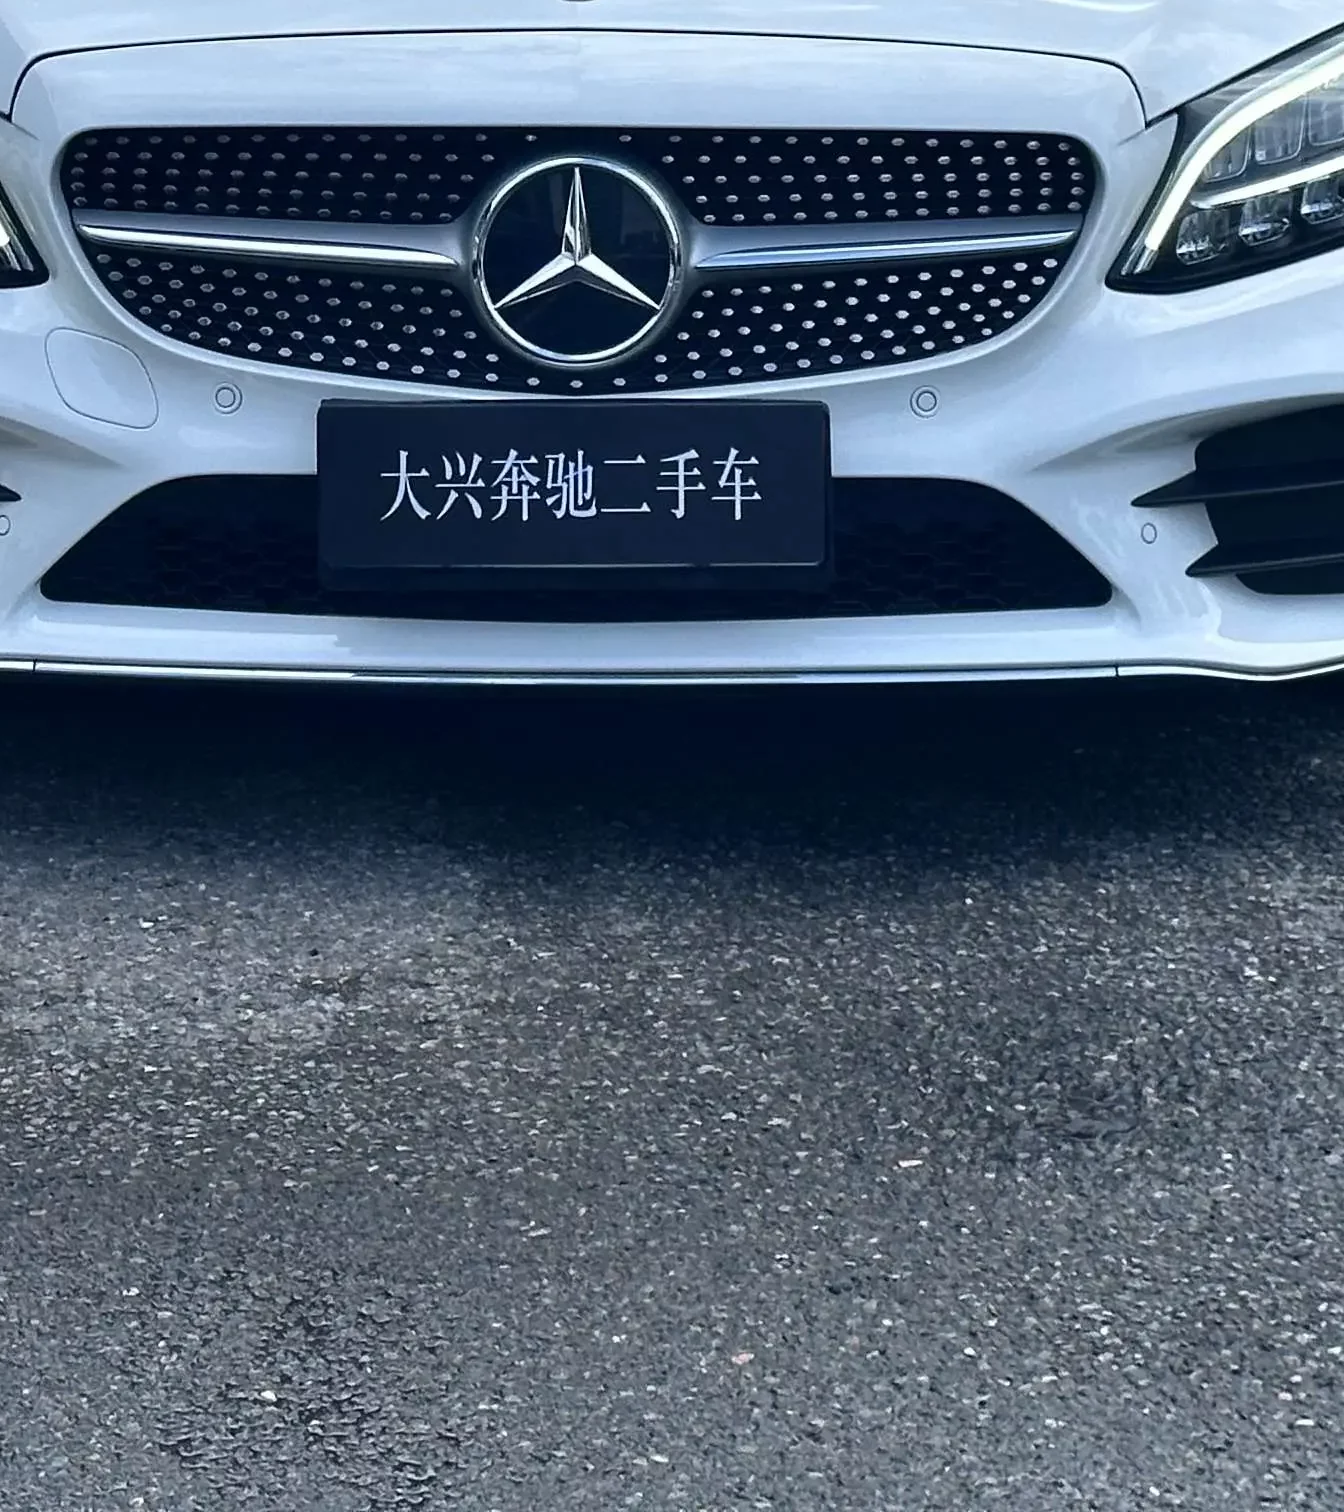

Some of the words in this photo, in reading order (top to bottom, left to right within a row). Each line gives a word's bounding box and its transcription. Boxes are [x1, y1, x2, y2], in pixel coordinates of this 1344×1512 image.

[379, 446, 764, 523] 大兴奔驰二手车
